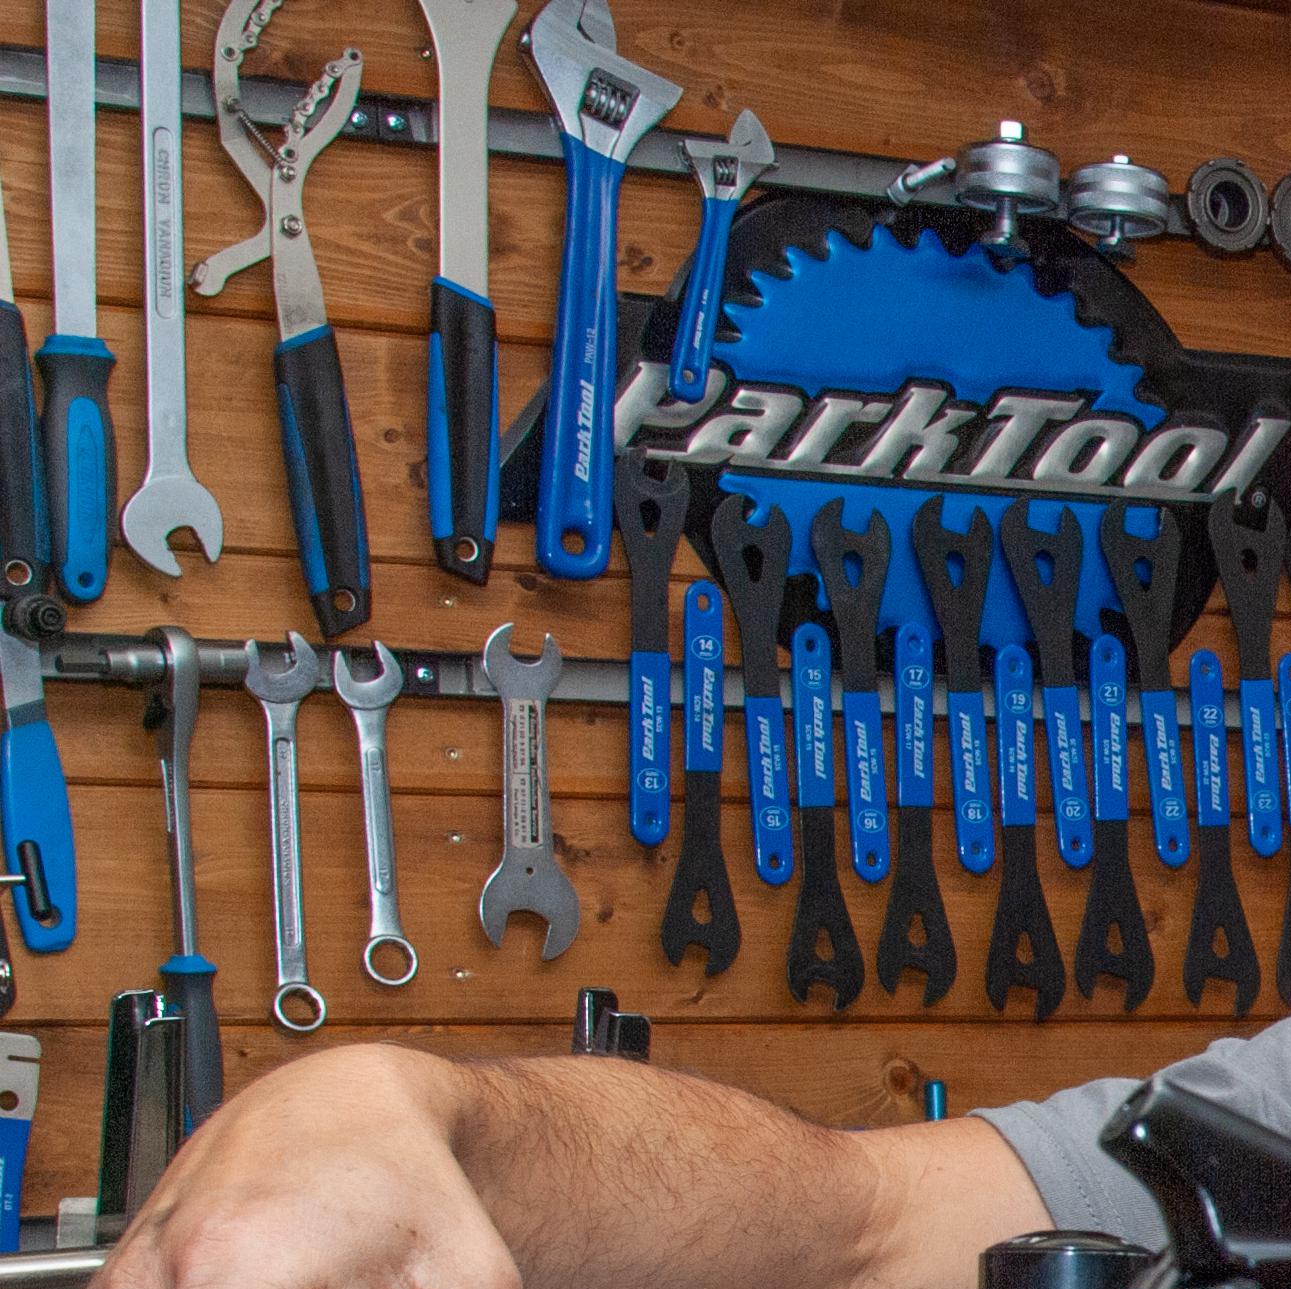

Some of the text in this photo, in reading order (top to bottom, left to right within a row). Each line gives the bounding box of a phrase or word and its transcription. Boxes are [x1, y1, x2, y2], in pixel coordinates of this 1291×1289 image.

[699, 639, 713, 650] 14
[808, 669, 821, 680] 15
[909, 669, 923, 680] 17
[1104, 686, 1118, 696] 21
[1012, 695, 1025, 704] 19
[1204, 709, 1217, 719] 22
[645, 778, 659, 789] 13
[968, 808, 981, 818] 18
[1066, 807, 1080, 816] 20
[1165, 807, 1179, 816] 22
[767, 816, 780, 827] 15
[864, 818, 877, 828] 16
